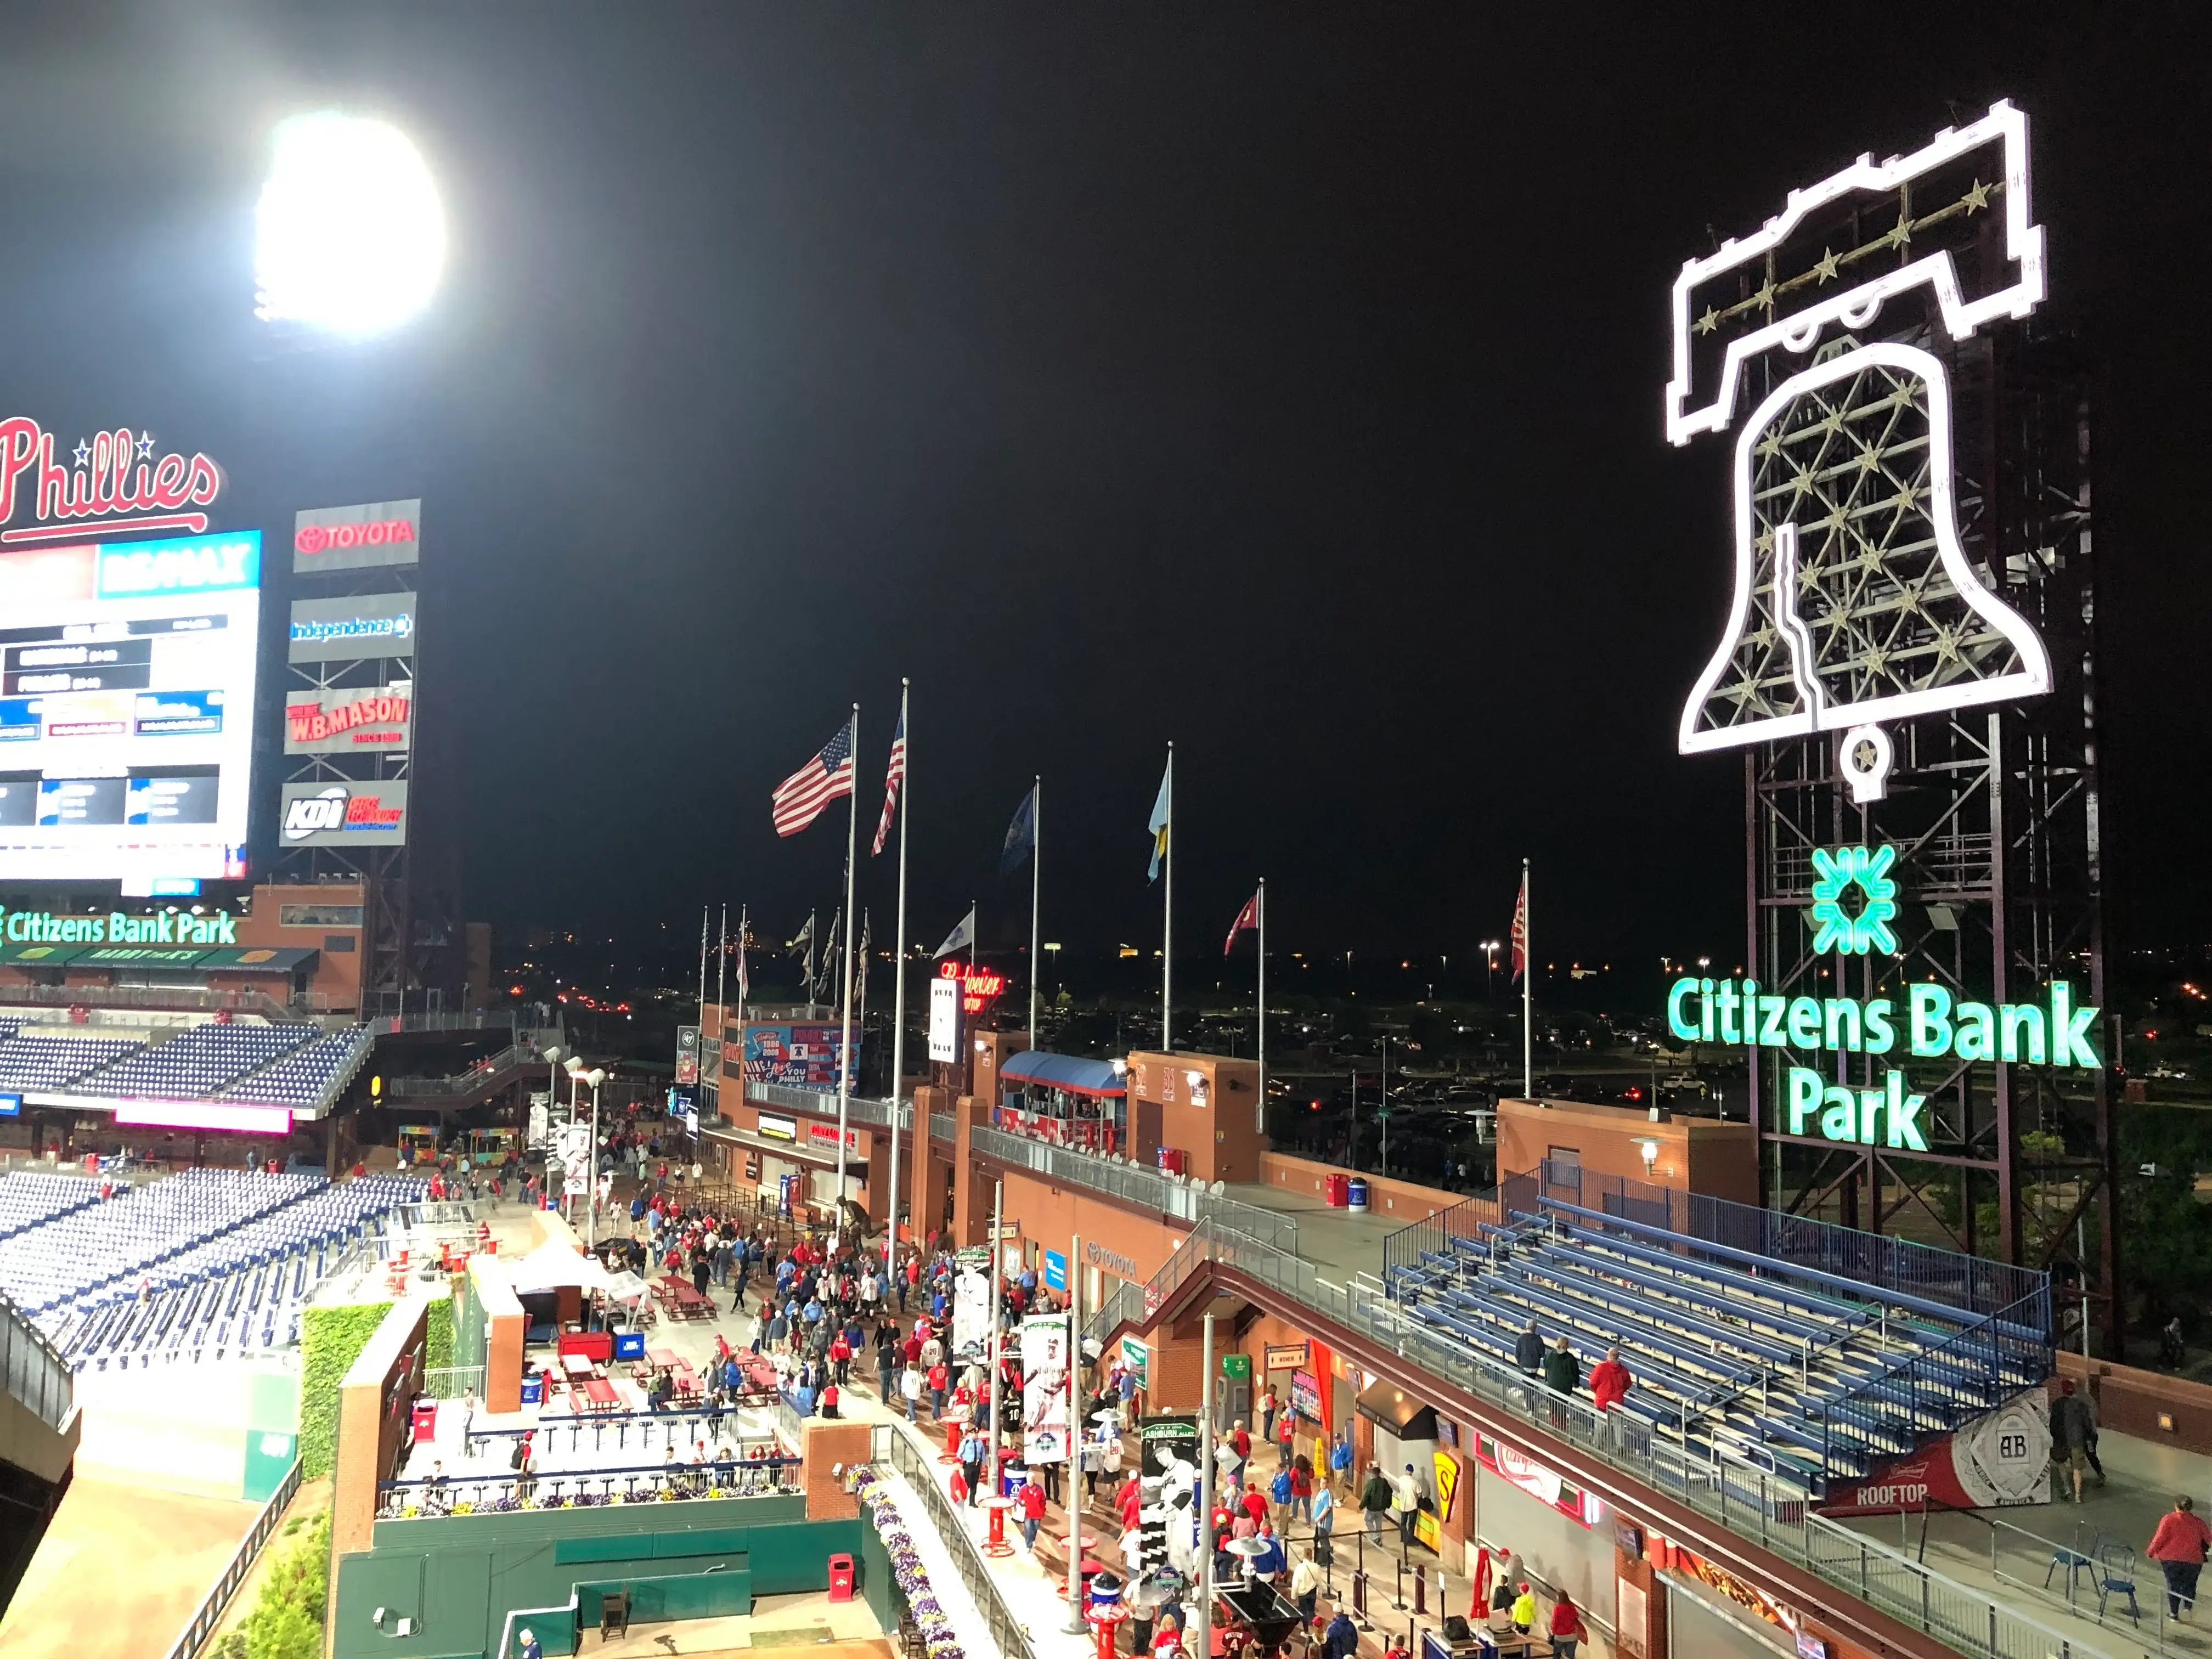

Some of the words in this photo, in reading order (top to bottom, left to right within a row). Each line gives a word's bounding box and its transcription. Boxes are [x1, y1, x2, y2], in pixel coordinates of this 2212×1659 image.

[0, 416, 219, 522] Phillies
[326, 519, 414, 549] TOYOTA
[289, 617, 393, 642] Independence
[328, 696, 408, 736] MASON
[348, 797, 380, 810] OFFICE
[7, 912, 105, 943] Citizens
[109, 911, 172, 944] Bank
[177, 911, 236, 944] Park
[1668, 977, 1896, 1054] Citizens
[1910, 980, 2103, 1069] Bank
[1788, 1066, 1931, 1152] Park
[1101, 1248, 1137, 1279] TOYOTA
[1009, 1409, 1019, 1421] 10
[1145, 1429, 1177, 1438] ASHBURN
[1110, 1446, 1119, 1455] 26
[1440, 1470, 1449, 1502] S
[1857, 1483, 1928, 1506] ROOFTOP
[1229, 1638, 1239, 1651] 4
